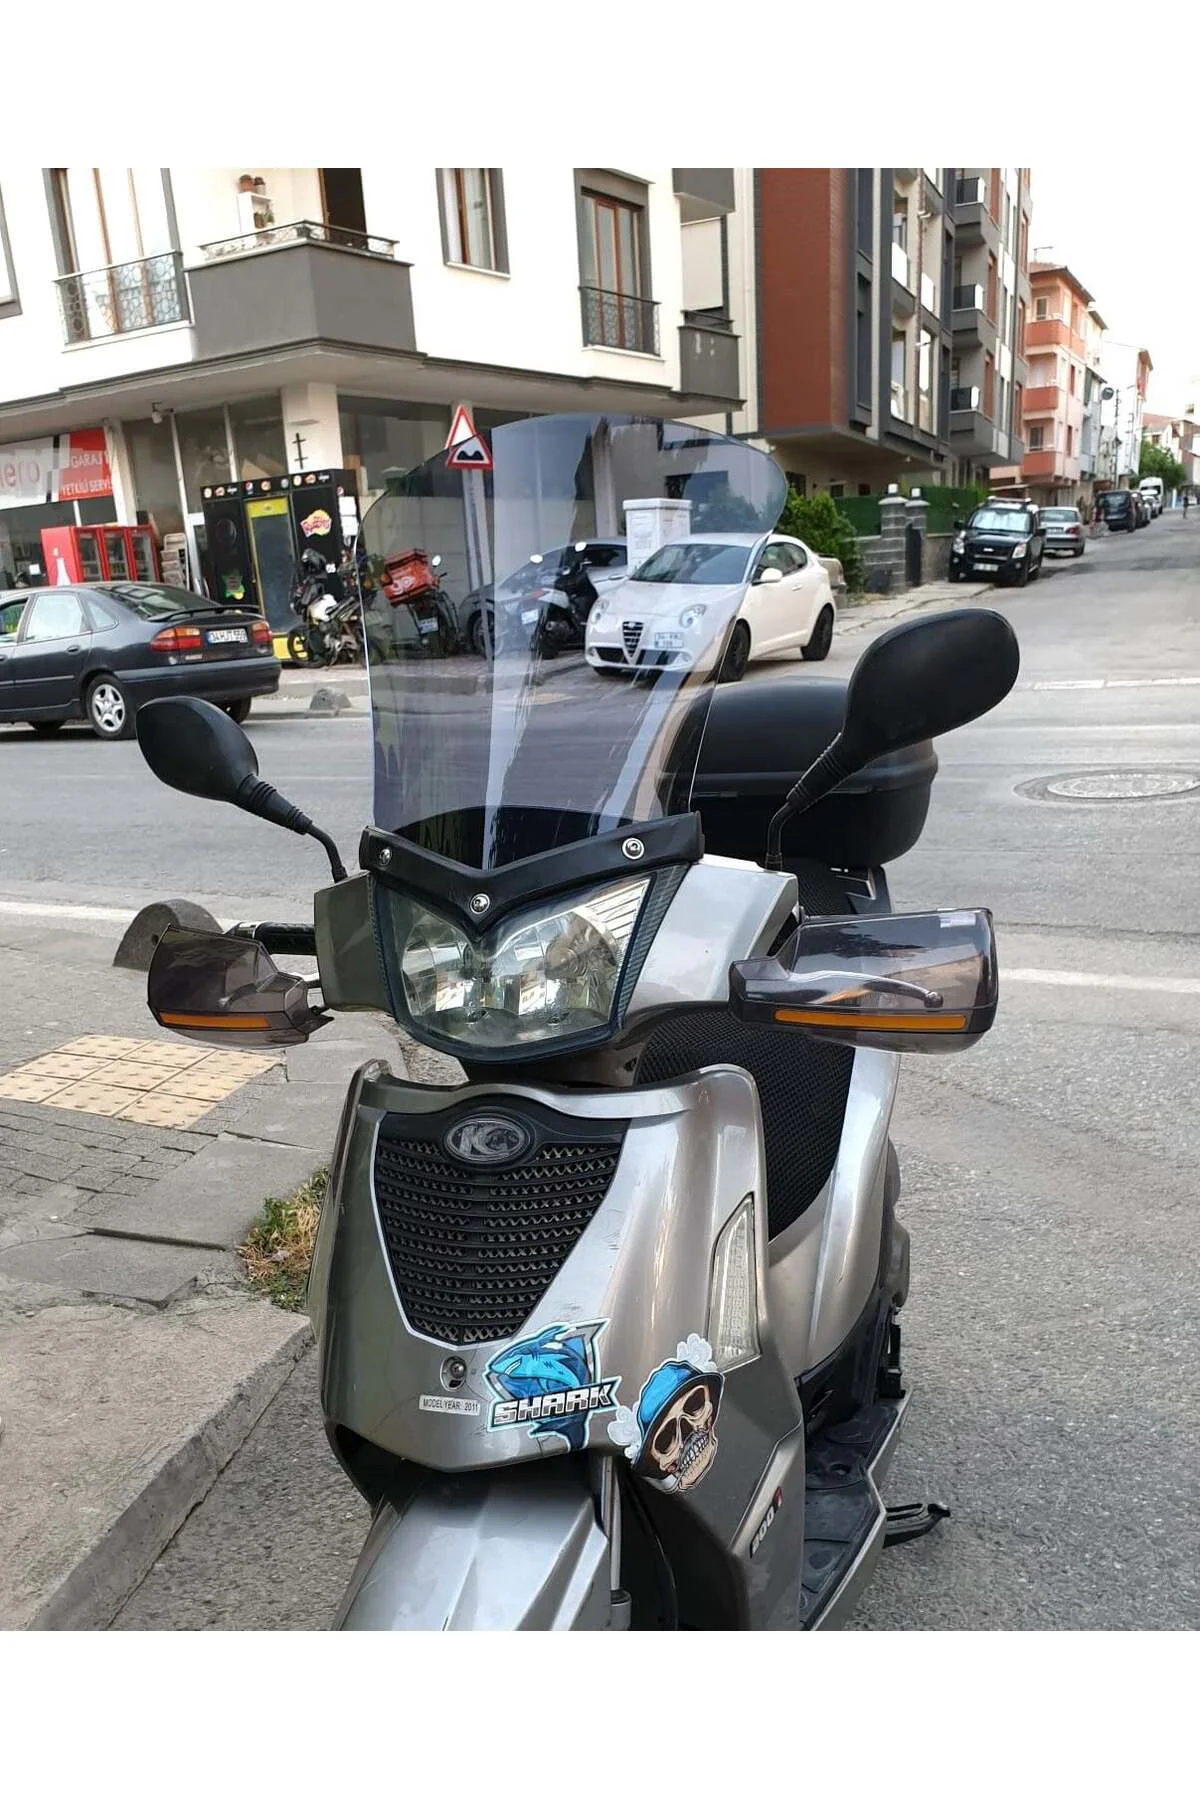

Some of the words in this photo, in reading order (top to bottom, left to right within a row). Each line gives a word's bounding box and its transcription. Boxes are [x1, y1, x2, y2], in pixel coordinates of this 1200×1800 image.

[423, 1398, 444, 1409] MODEL
[464, 1401, 479, 1412] 2011
[494, 1384, 612, 1425] SHARK
